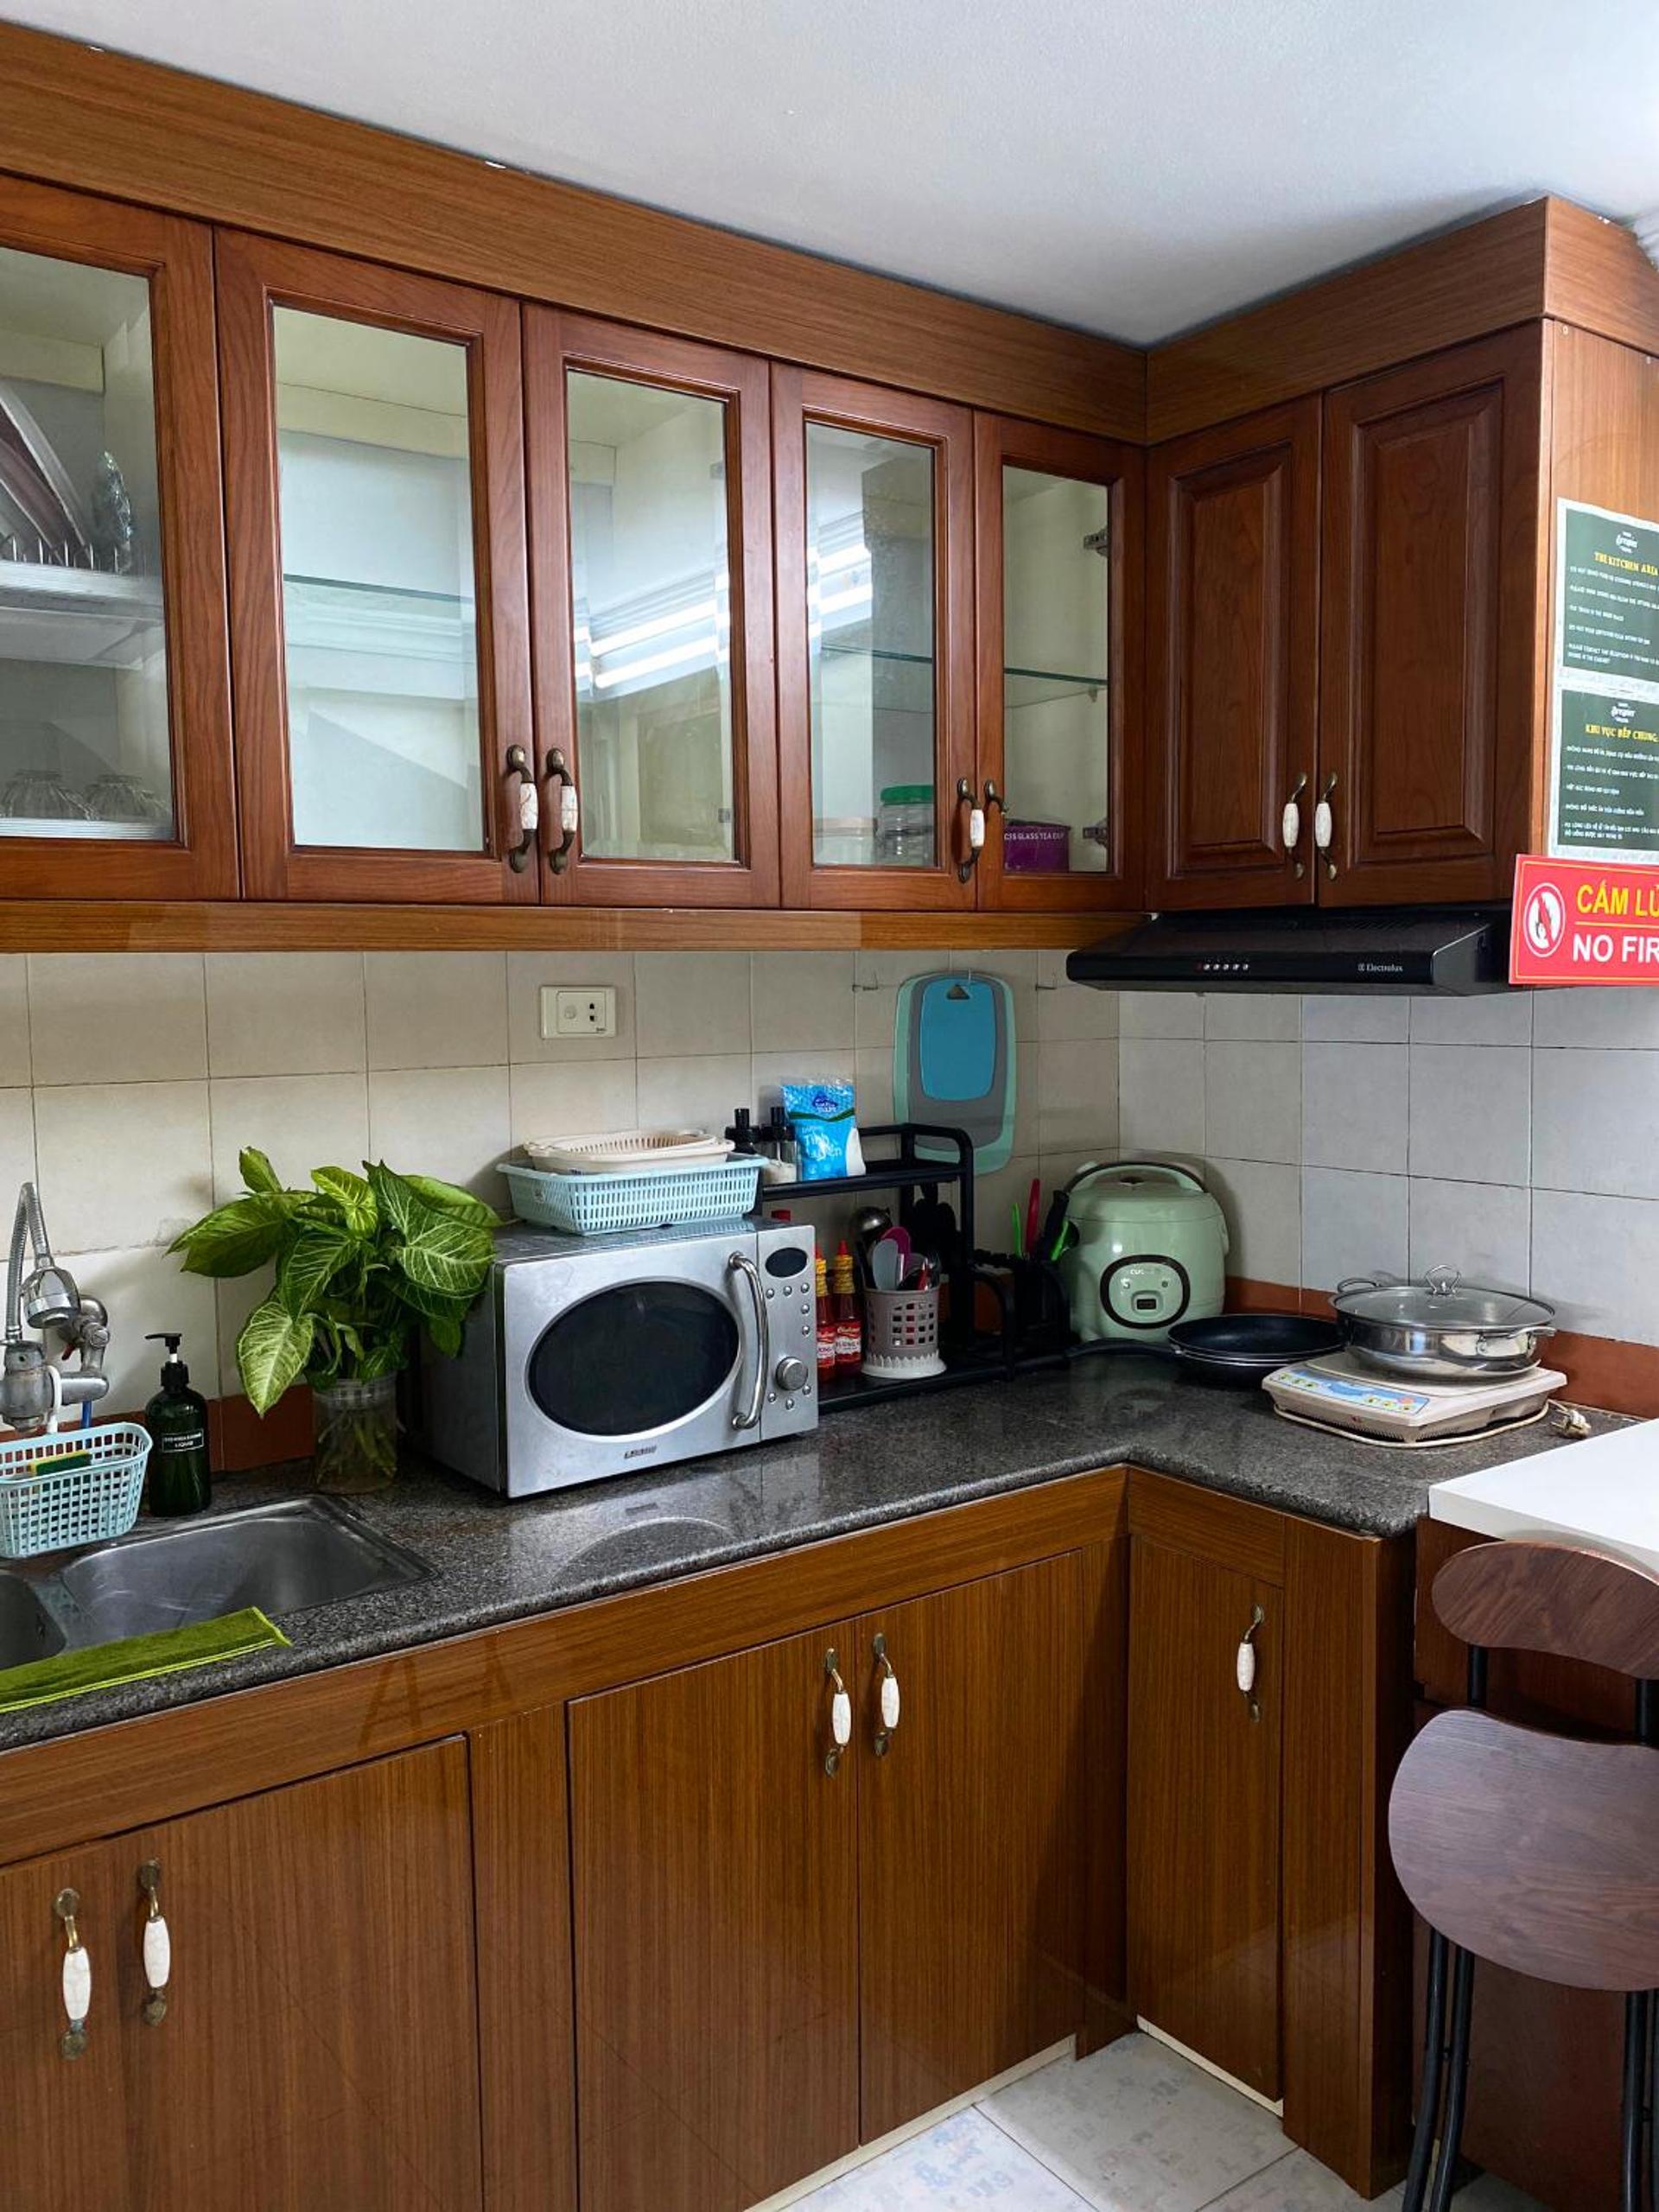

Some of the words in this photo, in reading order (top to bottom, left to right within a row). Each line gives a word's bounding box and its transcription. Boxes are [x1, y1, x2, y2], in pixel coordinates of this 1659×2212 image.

[1573, 933, 1614, 963] NO
[1621, 936, 1659, 963] FIR
[1366, 963, 1403, 972] Electrolux
